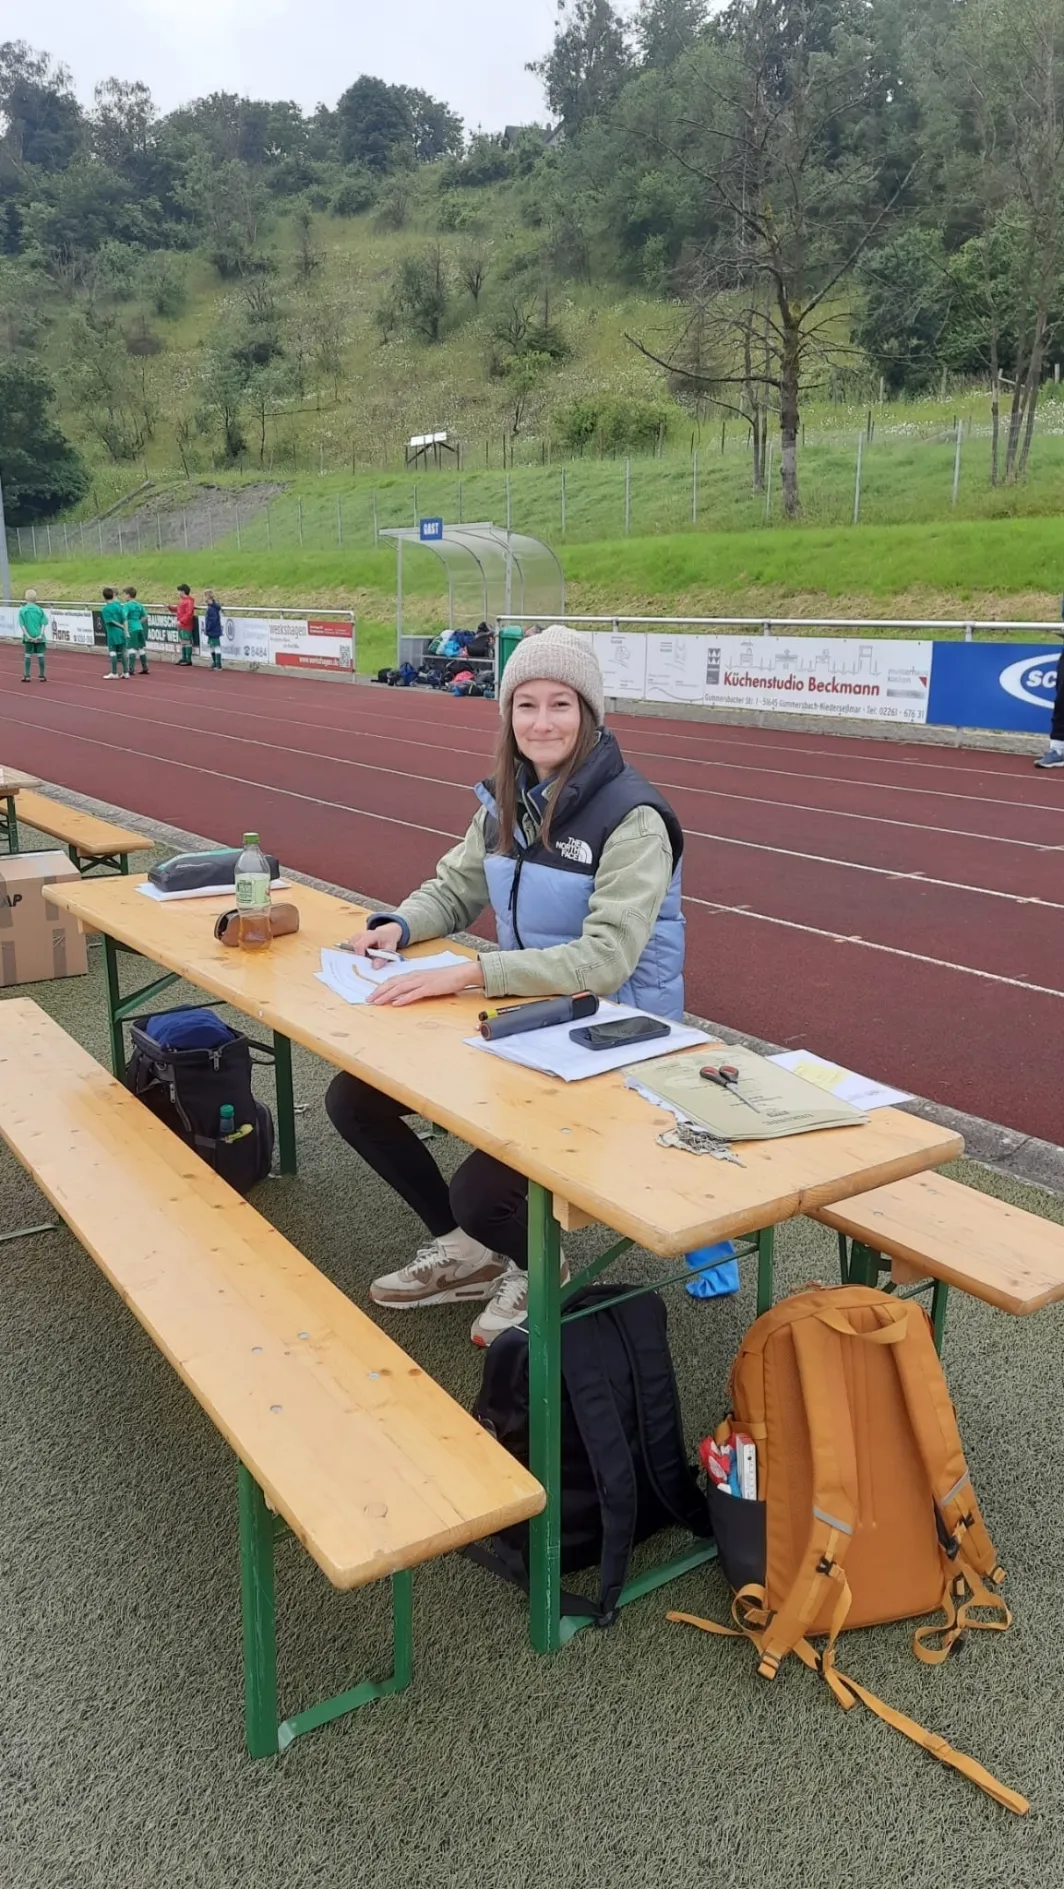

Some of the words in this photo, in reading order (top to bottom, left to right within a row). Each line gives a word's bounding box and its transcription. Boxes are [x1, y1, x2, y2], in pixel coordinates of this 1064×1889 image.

[423, 522, 440, 535] GAST
[147, 628, 166, 641] ADOLF
[724, 671, 804, 691] Küchenstudio
[808, 676, 880, 696] Beckmann
[556, 841, 580, 855] NORTH
[568, 836, 582, 847] THE
[561, 849, 580, 861] FACE
